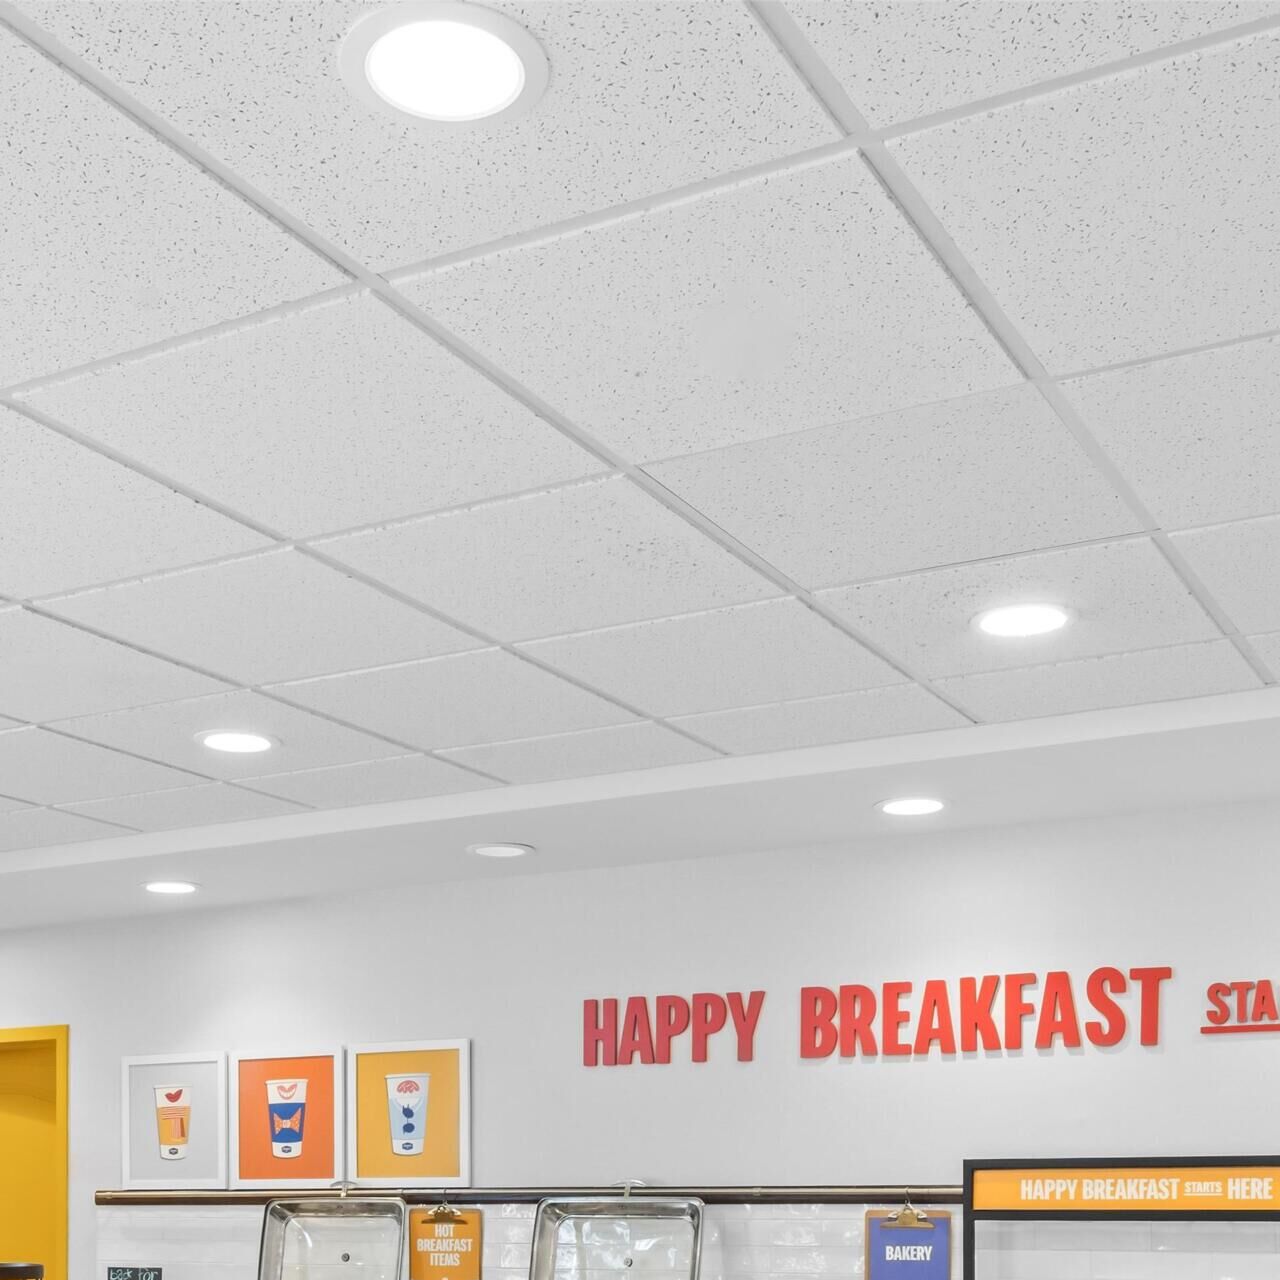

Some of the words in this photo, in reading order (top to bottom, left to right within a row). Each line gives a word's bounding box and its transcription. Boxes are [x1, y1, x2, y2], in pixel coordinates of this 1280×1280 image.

[583, 990, 766, 1066] HAPPY
[800, 966, 1172, 1059] BREAKFAST
[1020, 1179, 1077, 1200] HAPPY
[1082, 1178, 1180, 1200] BREAKFAST
[1184, 1181, 1222, 1194] STARTS
[1228, 1178, 1273, 1199] HERE
[434, 1224, 455, 1238] HOT
[416, 1239, 473, 1252] BREAKFAST
[885, 1245, 933, 1261] BAKERY
[430, 1253, 460, 1266] ITEMS
